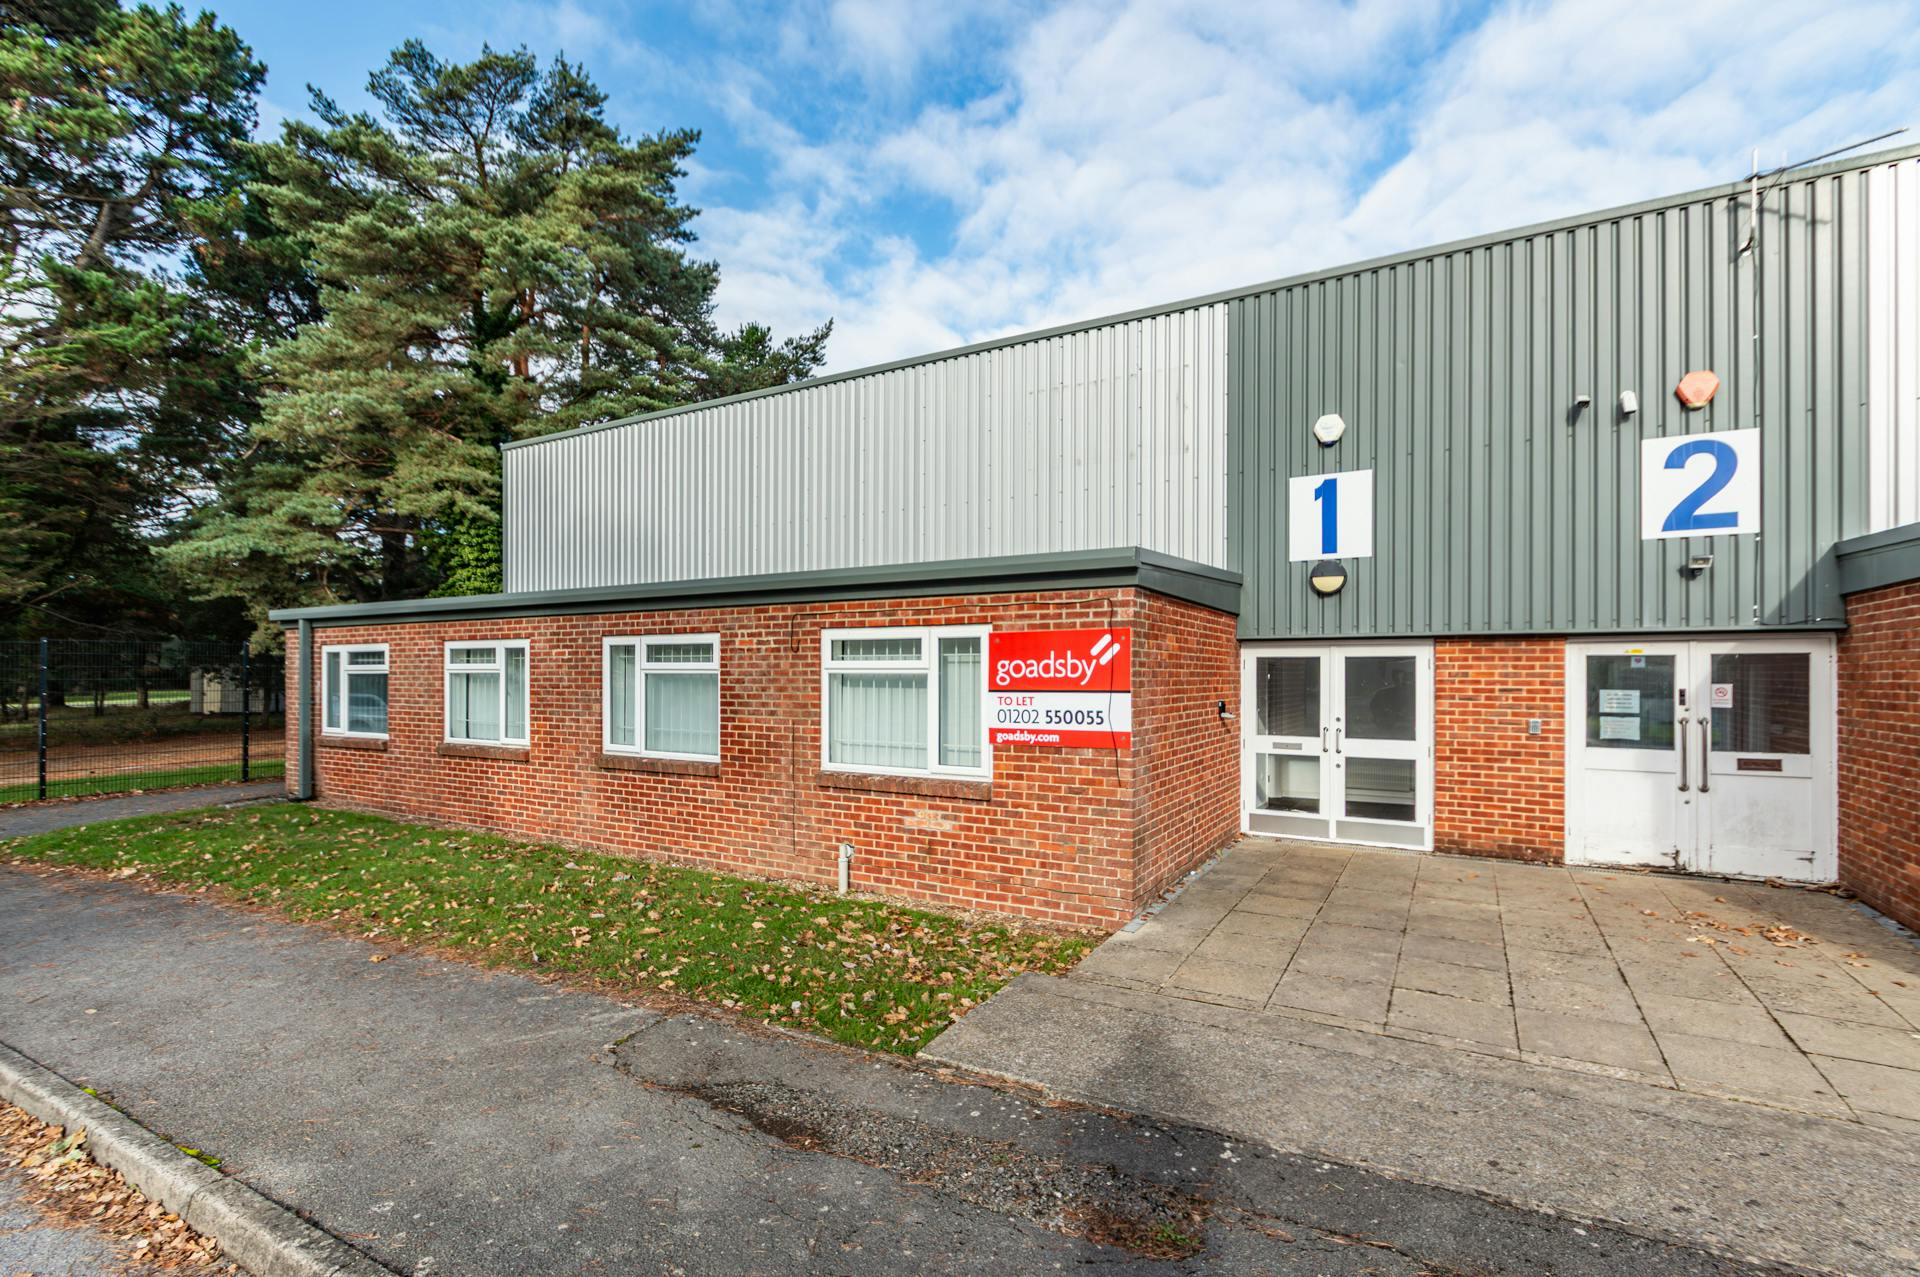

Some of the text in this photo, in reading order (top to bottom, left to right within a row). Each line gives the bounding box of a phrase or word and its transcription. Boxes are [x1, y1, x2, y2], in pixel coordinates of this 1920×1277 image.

[1661, 439, 1739, 532] 2
[1314, 478, 1338, 554] 1
[996, 650, 1097, 686] goadsby
[997, 696, 1035, 706] TO LET
[997, 708, 1104, 725] 01202 550055
[996, 730, 1060, 744] goadsby.com
